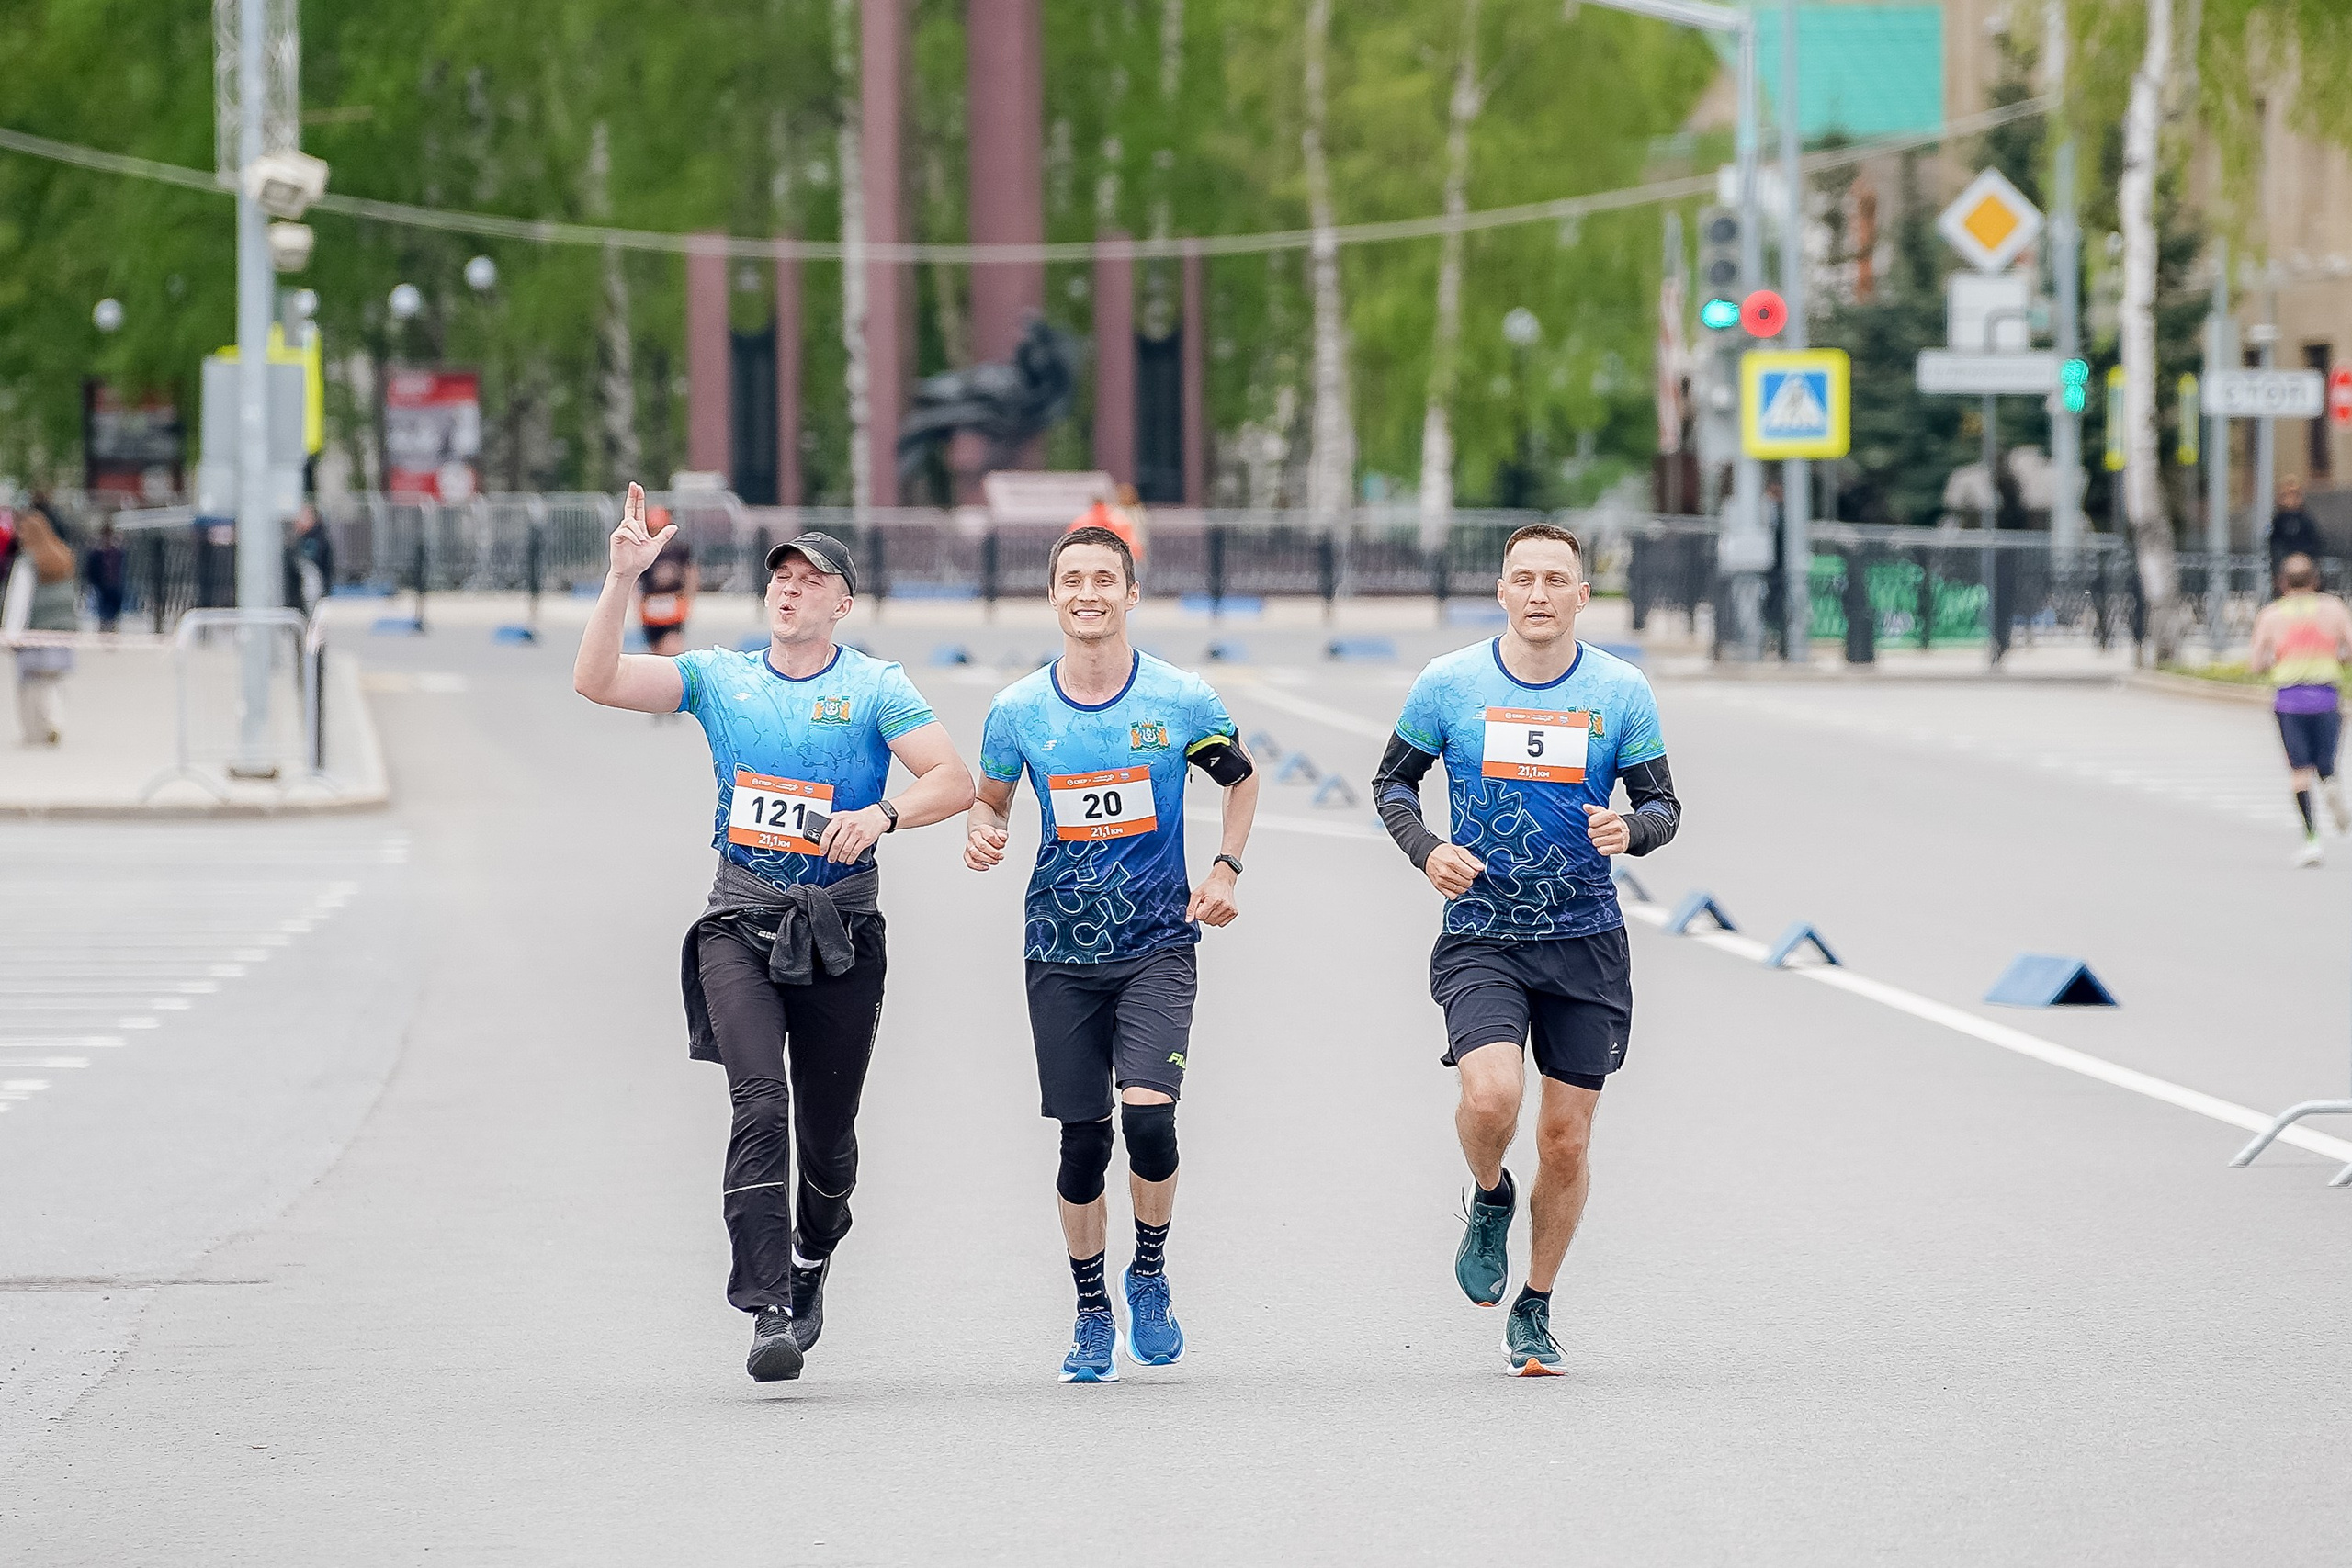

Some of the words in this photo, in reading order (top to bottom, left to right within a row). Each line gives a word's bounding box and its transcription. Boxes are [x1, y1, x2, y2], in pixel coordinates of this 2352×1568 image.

[1527, 730, 1544, 758] 5
[752, 796, 806, 830] 121
[1082, 790, 1122, 819] 20
